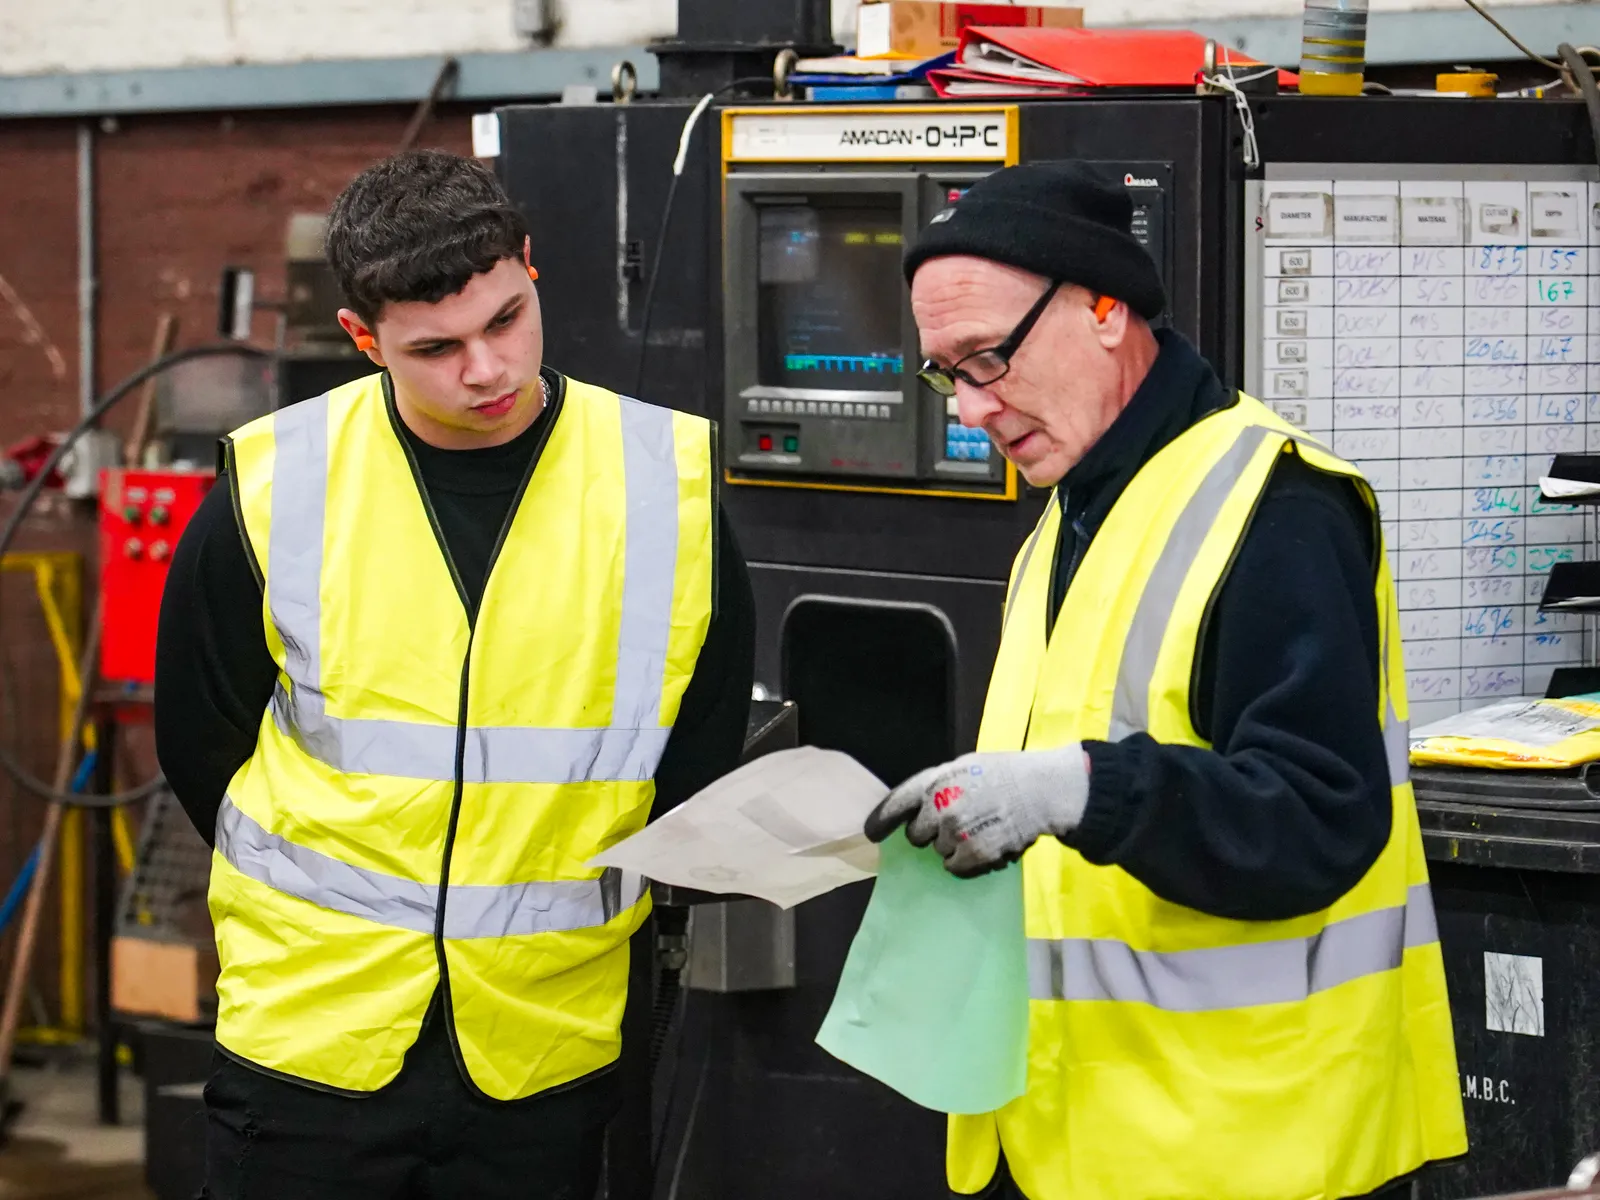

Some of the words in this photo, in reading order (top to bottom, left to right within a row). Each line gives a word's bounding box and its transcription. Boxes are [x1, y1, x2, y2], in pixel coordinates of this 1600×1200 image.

[1280, 211, 1312, 219] DIAMETER
[1289, 257, 1303, 266] 600
[1540, 249, 1579, 271] 155
[1285, 286, 1299, 295] 600
[1538, 280, 1575, 302] 167
[1537, 395, 1580, 422] 148
[1457, 1073, 1516, 1105] .M.B.C.
